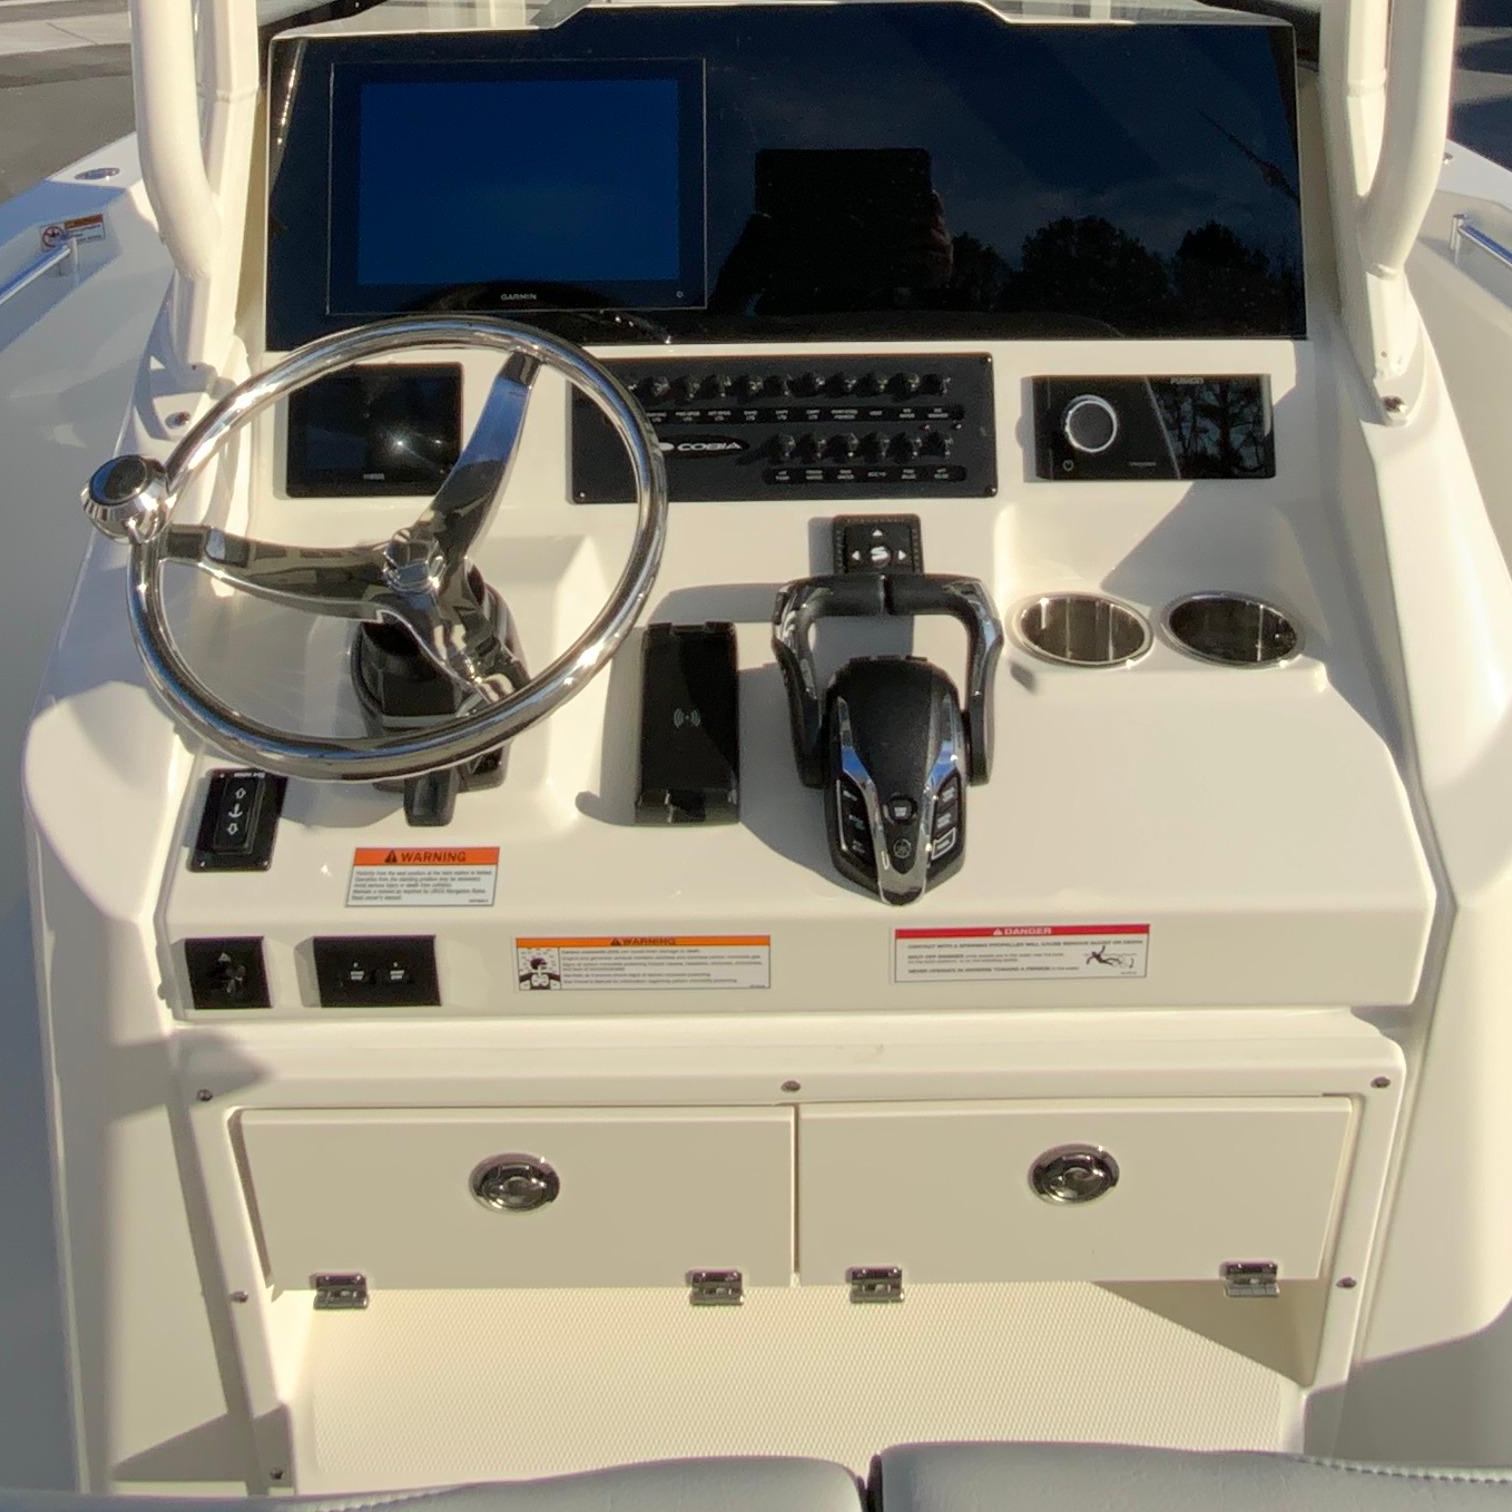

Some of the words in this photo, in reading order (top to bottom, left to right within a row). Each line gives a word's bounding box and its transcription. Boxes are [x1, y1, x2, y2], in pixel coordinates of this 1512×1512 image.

[676, 441, 744, 452] COBIA
[400, 851, 468, 863] WARNING
[1004, 927, 1053, 936] DANGER
[622, 937, 677, 947] WARNING
